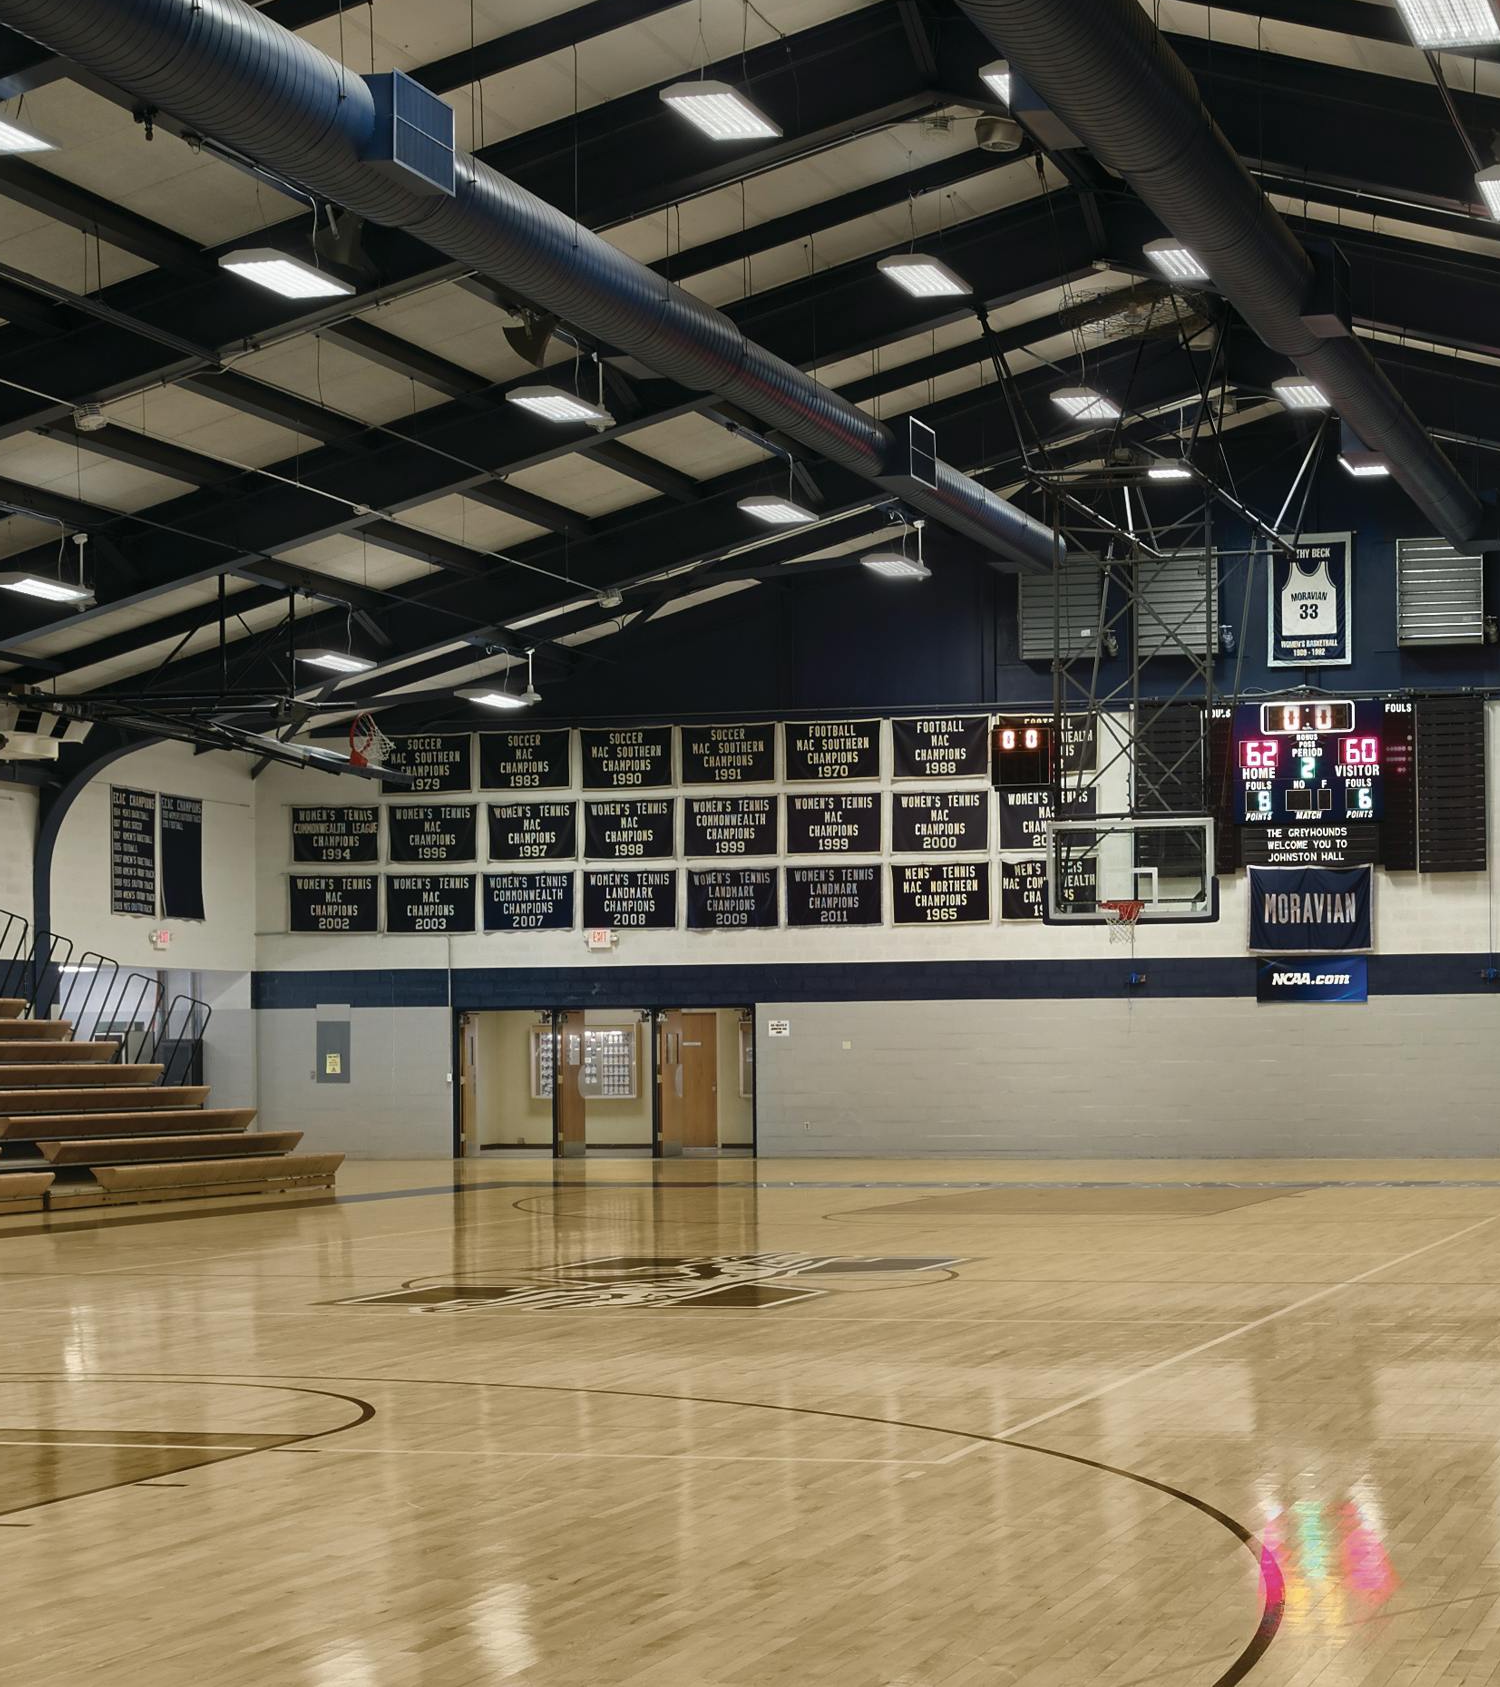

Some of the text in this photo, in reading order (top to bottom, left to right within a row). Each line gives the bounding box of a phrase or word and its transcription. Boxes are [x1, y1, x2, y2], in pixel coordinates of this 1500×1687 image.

[1312, 547, 1330, 558] BECK
[1291, 592, 1327, 602] MORAVIAN
[1299, 604, 1319, 619] 33
[1385, 704, 1411, 712] FOULS
[809, 725, 856, 737] FOOTBALL
[917, 721, 964, 733] FOOTBALL
[508, 735, 541, 746] SOCCER
[797, 738, 869, 751] MAC SOUTHERN
[932, 735, 949, 746] MAC
[516, 749, 532, 760] MAC
[915, 748, 966, 760] CHAMPIONS
[1246, 742, 1277, 766] 62
[1292, 748, 1322, 757] PERIOD
[1345, 739, 1376, 763] 60
[808, 752, 858, 764] CHAMPIONS
[500, 761, 549, 772] CHAMPIONS
[818, 766, 848, 777] 1970
[926, 762, 956, 774] 1988
[1301, 758, 1315, 778] 2
[1335, 765, 1379, 777] VISITOR
[1243, 768, 1275, 779] HOME
[510, 775, 539, 786] 1983
[1246, 781, 1272, 790] FOULS
[1293, 780, 1305, 789] NO
[1321, 780, 1327, 789] F
[1346, 778, 1372, 787] FOULS
[129, 794, 155, 810] CHAMPIONS
[902, 794, 980, 808] WOMEN'S TENNIS
[1358, 789, 1372, 809] 6
[693, 800, 769, 812] WOMEN'S TENNIS
[931, 810, 948, 821] MAC
[1246, 812, 1272, 821] POINTS
[1296, 811, 1321, 819] MATCH
[1347, 810, 1373, 818] POINTS
[696, 814, 766, 826] COMMONWEALTH
[706, 828, 755, 839] CHAMPIONS
[915, 823, 965, 834] CHAMPIONS
[1267, 827, 1347, 838] THE GREYHOUNDS
[716, 842, 744, 853] 1999
[923, 837, 956, 848] 2000
[1268, 840, 1347, 850] WELCOME YOU TO
[1268, 851, 1344, 862] JOHNSTON HALL
[905, 866, 975, 880] MENS' TENNIS
[490, 876, 567, 888] WOMEN'S TENNIS
[904, 880, 978, 893] MAC NORTHERN
[494, 889, 563, 901] COMMONWEALTH
[916, 894, 967, 906] CHAMPIONS
[504, 902, 553, 914] CHAMPIONS
[1265, 892, 1356, 924] MORAVIAN
[926, 908, 956, 920] 1965
[513, 916, 543, 927] 2007
[1272, 972, 1350, 986] NCAA.com
